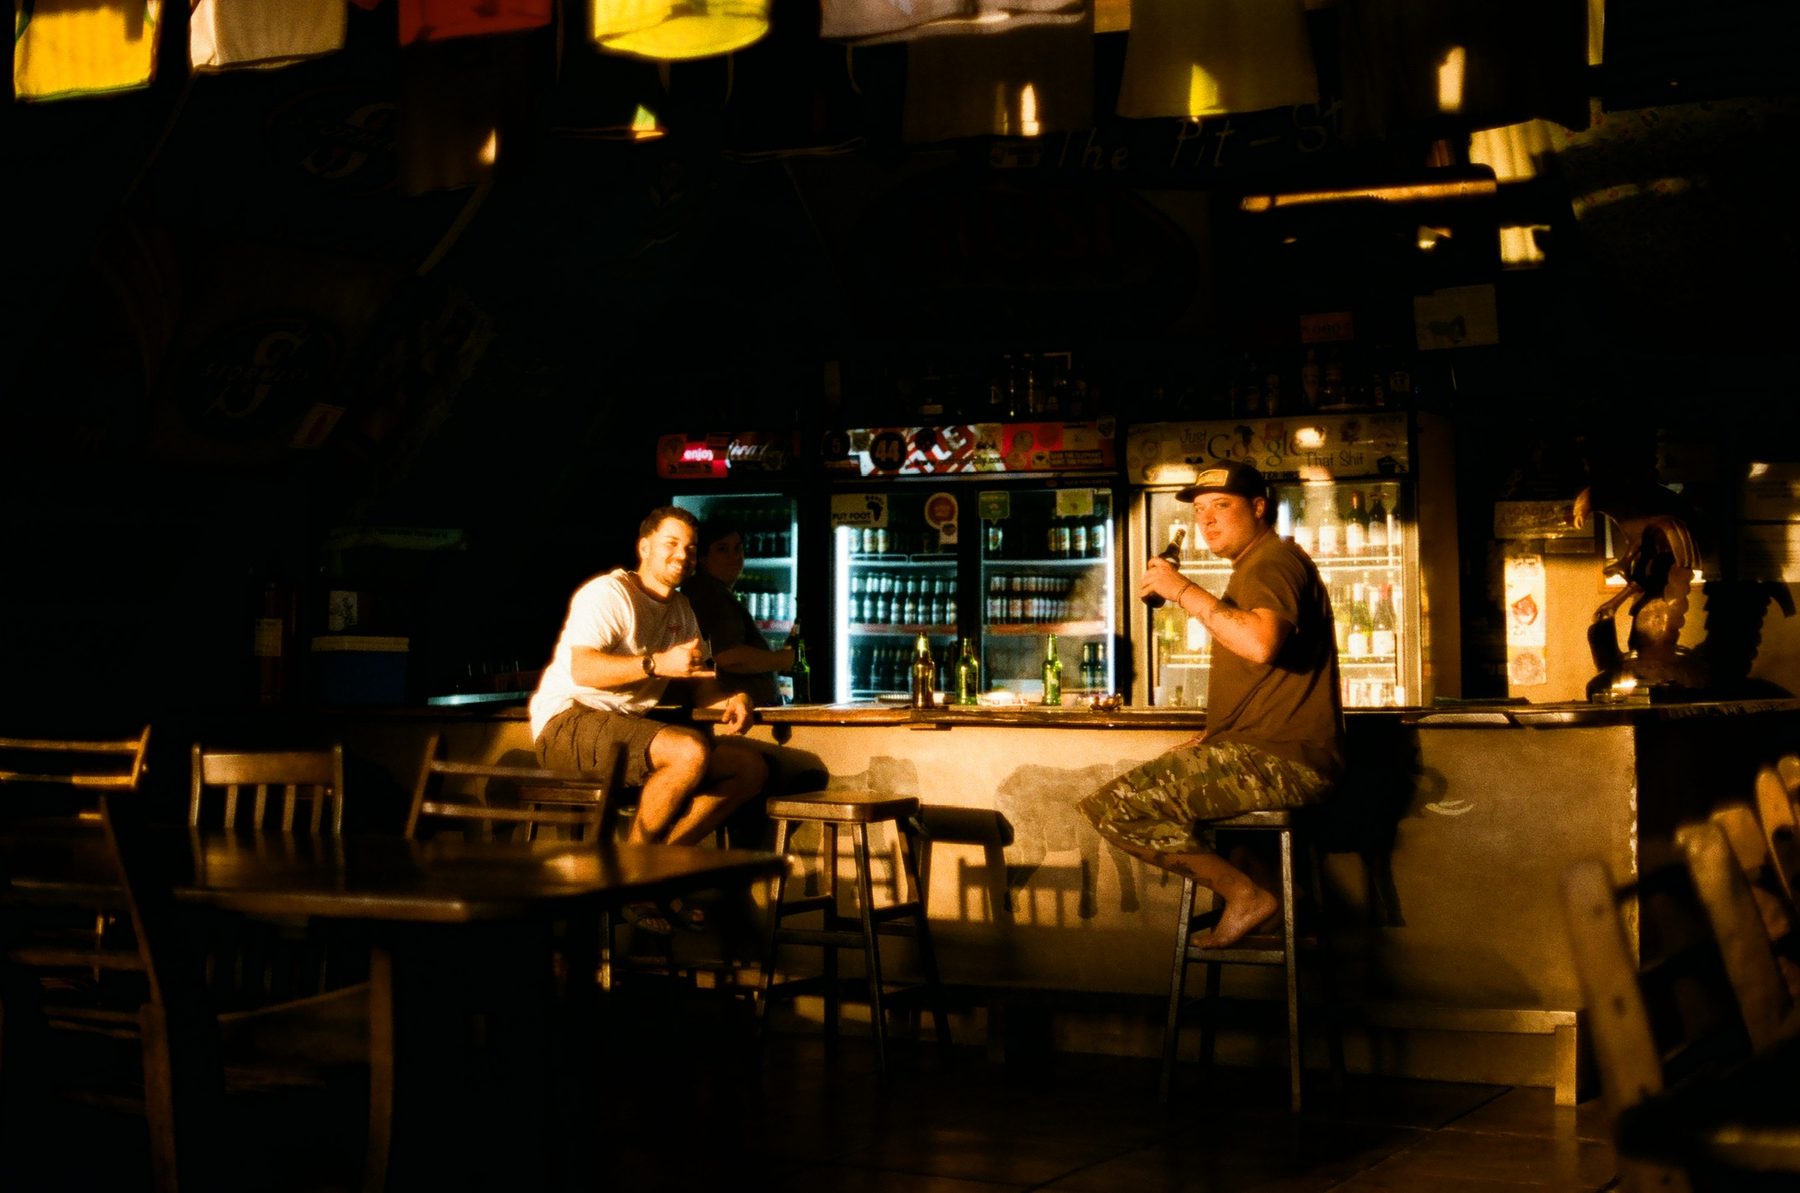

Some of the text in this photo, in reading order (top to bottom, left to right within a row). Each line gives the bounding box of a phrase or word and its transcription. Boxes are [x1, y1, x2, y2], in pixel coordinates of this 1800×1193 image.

[1056, 128, 1130, 172] The
[1169, 118, 1236, 170] Pit
[1180, 428, 1206, 443] Just
[683, 447, 714, 461] enjoy
[875, 438, 900, 463] 44
[1305, 450, 1364, 467] That Shit
[832, 511, 872, 521] PUT FOOT
